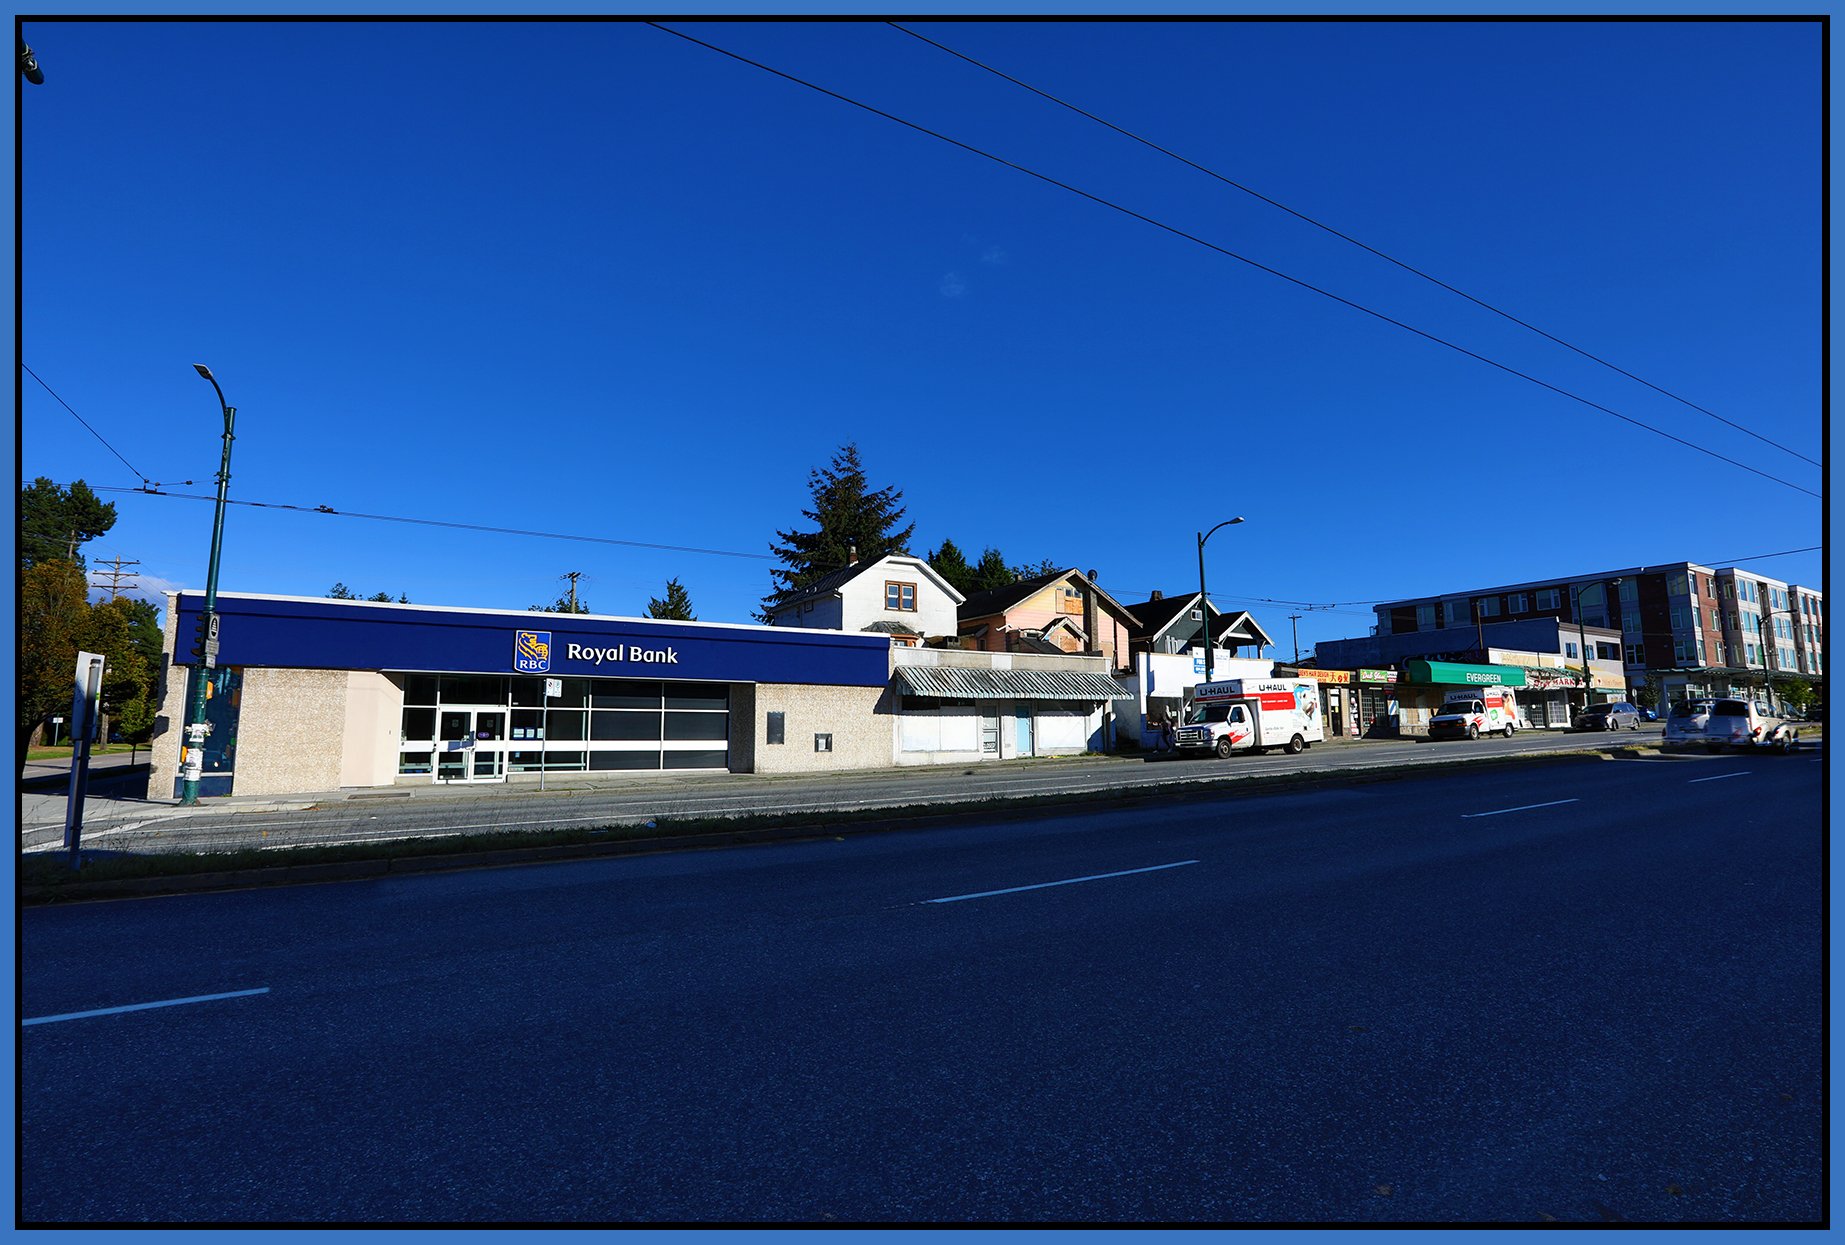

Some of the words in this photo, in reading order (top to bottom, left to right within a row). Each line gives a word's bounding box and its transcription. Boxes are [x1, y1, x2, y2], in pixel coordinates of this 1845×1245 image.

[568, 643, 624, 665] Royal
[630, 646, 678, 664] Bank
[519, 659, 546, 670] RBC
[1466, 672, 1502, 684] EVERGREEN
